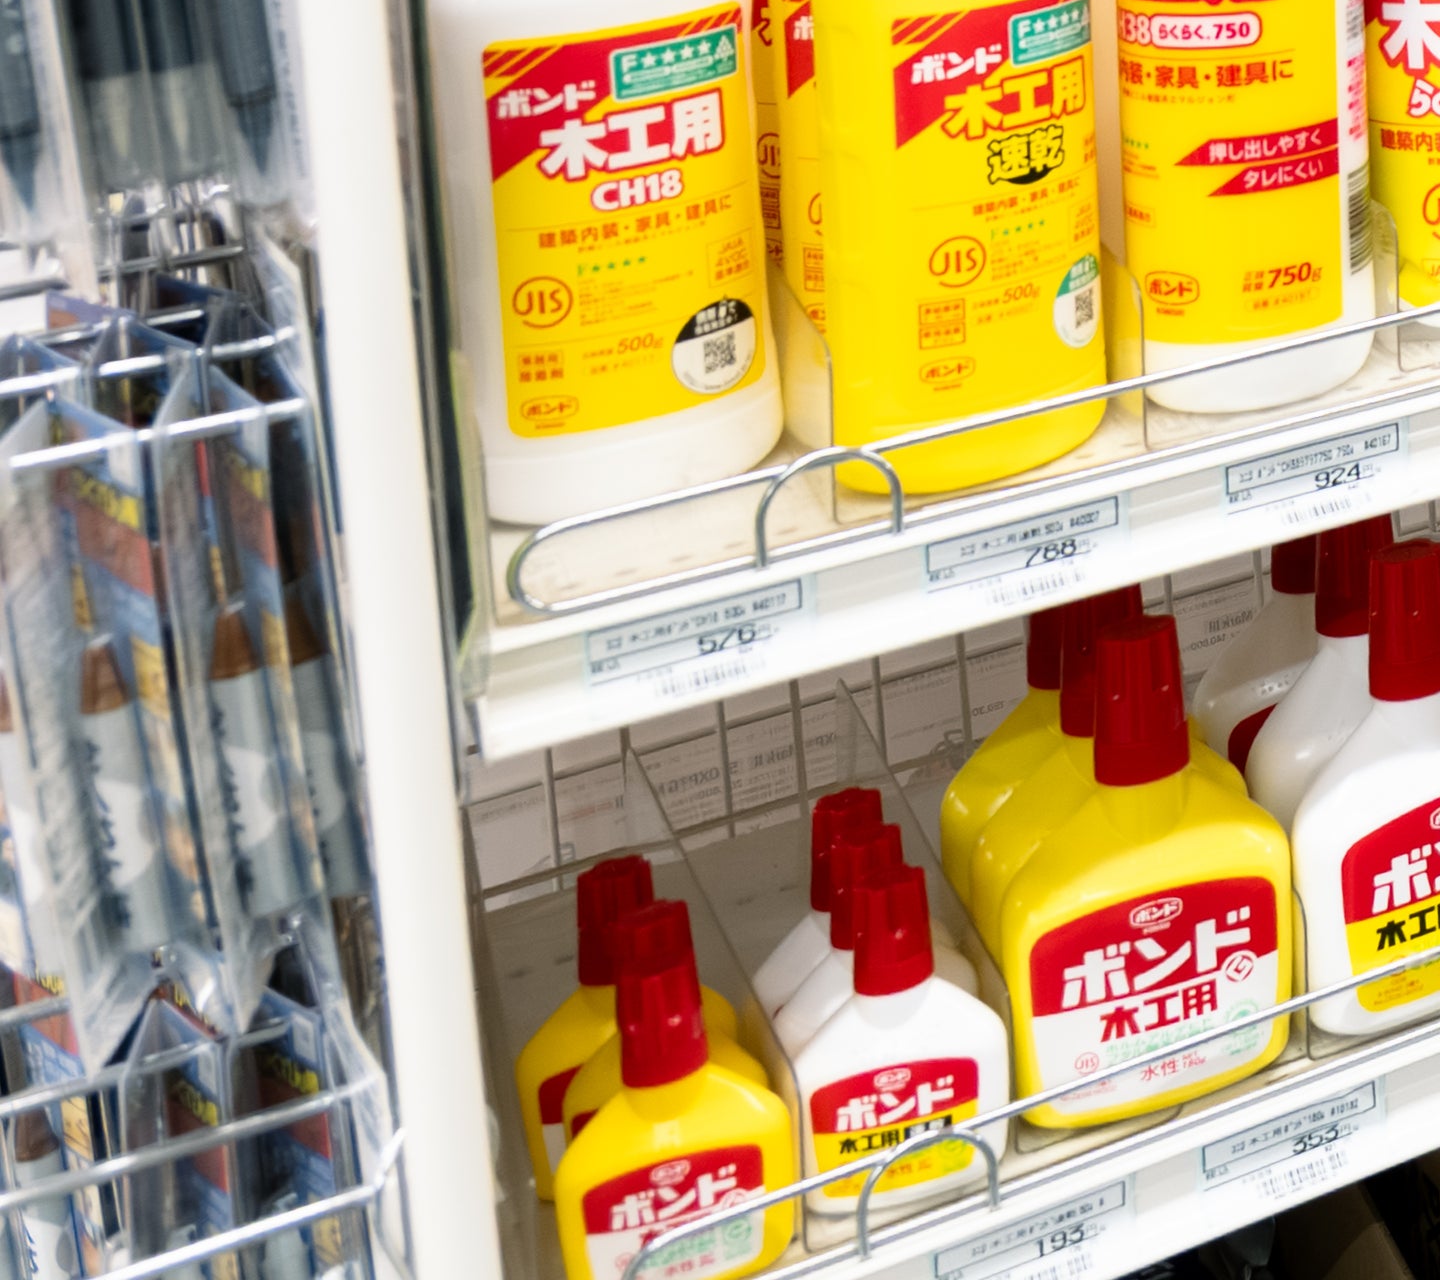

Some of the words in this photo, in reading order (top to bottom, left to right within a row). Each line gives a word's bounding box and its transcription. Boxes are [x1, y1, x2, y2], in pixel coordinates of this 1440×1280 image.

[499, 83, 596, 118] ボンド
[941, 57, 1088, 138] 木工用
[541, 90, 726, 178] 木工用
[1208, 126, 1322, 166] 押し出しやすく
[988, 125, 1065, 185] 速乾
[1242, 157, 1325, 188] タレにくい
[592, 170, 684, 211] CH18
[1313, 464, 1363, 489] 924
[1060, 907, 1252, 1008] ボンド
